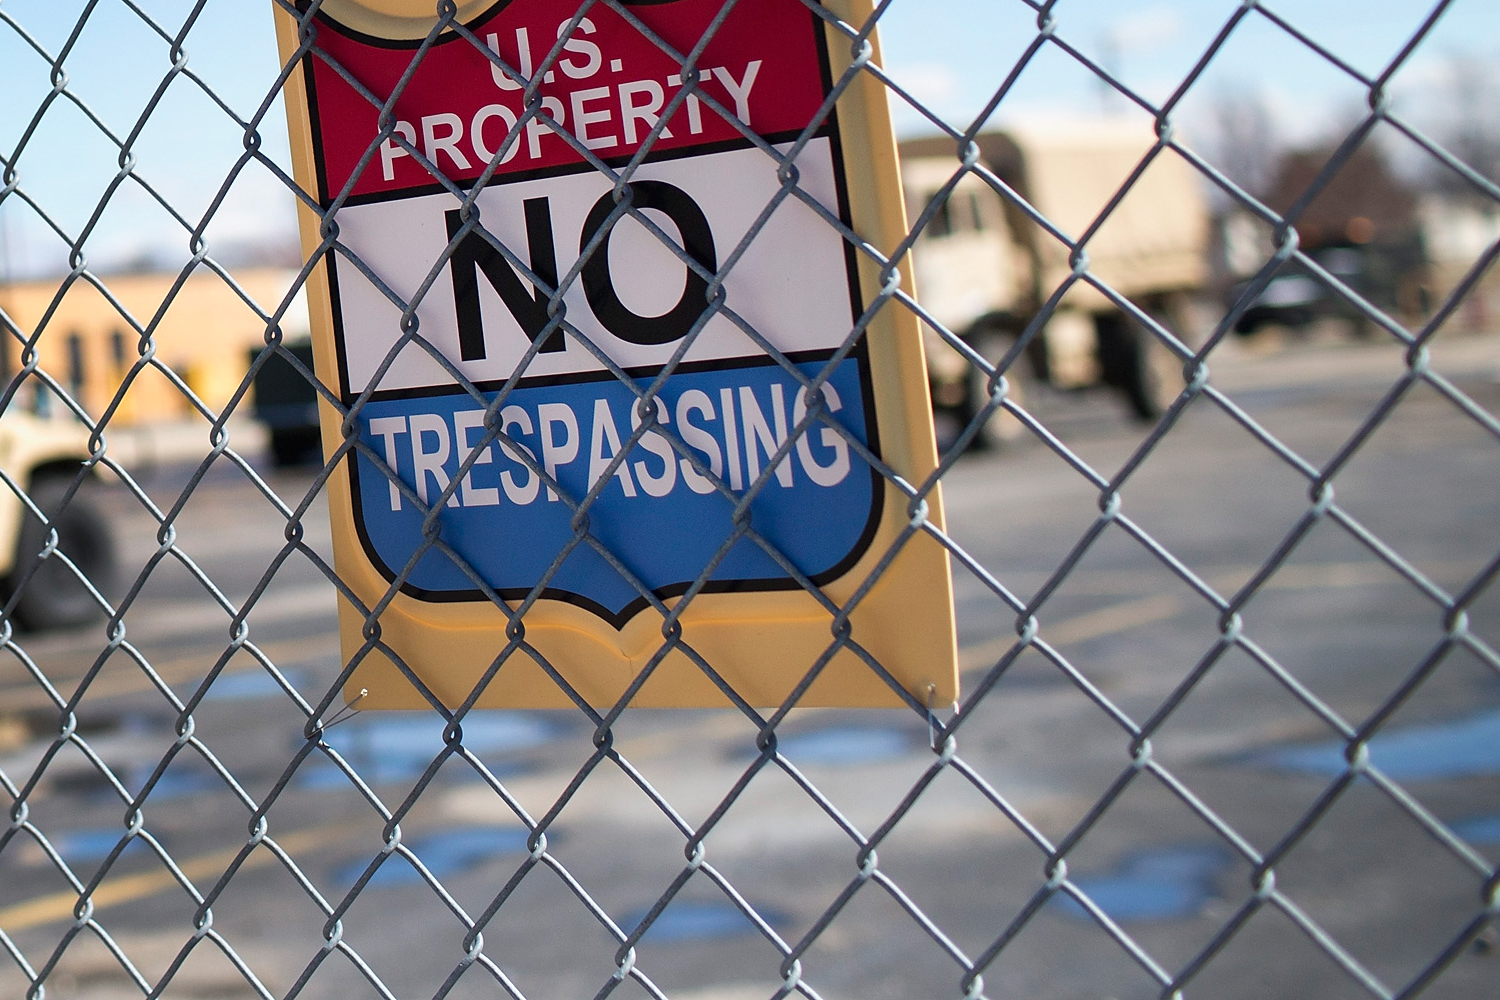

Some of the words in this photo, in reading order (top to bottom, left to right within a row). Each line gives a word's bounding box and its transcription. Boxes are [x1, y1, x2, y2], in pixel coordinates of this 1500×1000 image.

[487, 17, 623, 91] U.S.
[378, 61, 763, 181] PROPERTY
[444, 180, 717, 362] NO
[369, 382, 851, 511] TRESPASSING
